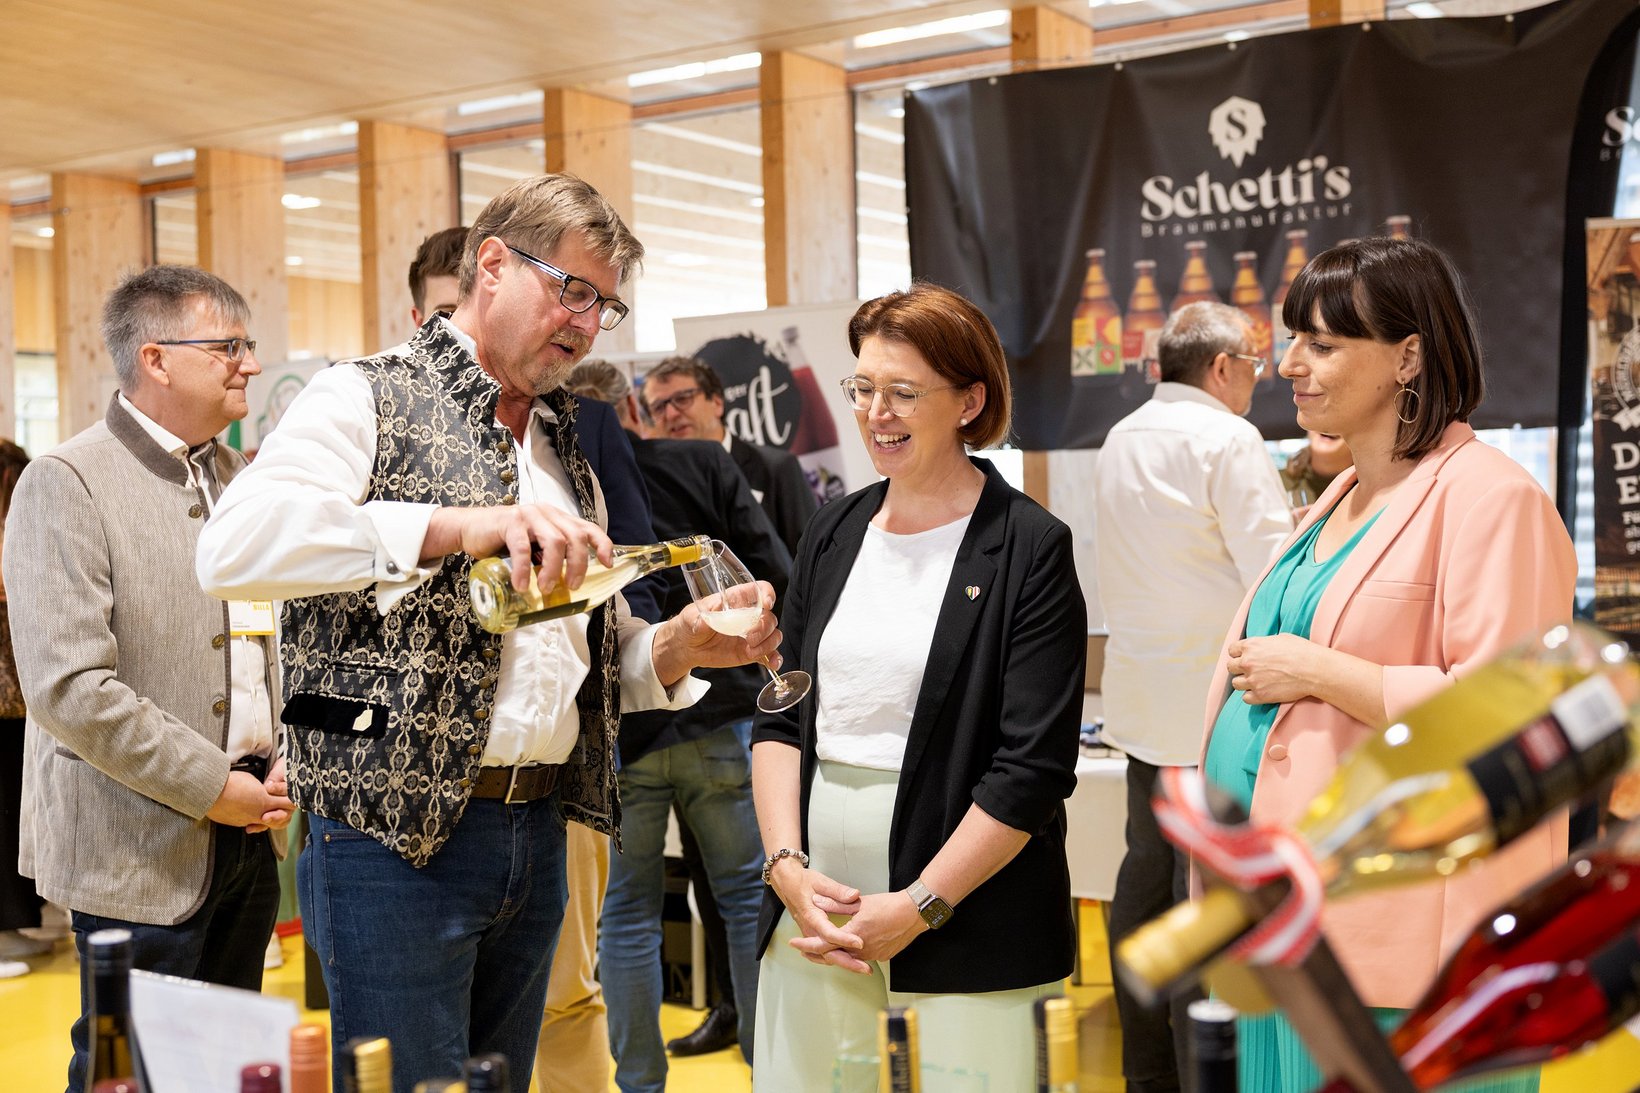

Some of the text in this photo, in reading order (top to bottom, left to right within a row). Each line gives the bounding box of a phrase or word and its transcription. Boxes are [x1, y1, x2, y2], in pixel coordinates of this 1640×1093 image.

[1226, 107, 1247, 142] S
[1141, 155, 1352, 222] Schetti's
[1141, 203, 1352, 238] Braumanufaktur
[1611, 441, 1640, 471] D
[1616, 475, 1640, 505] E
